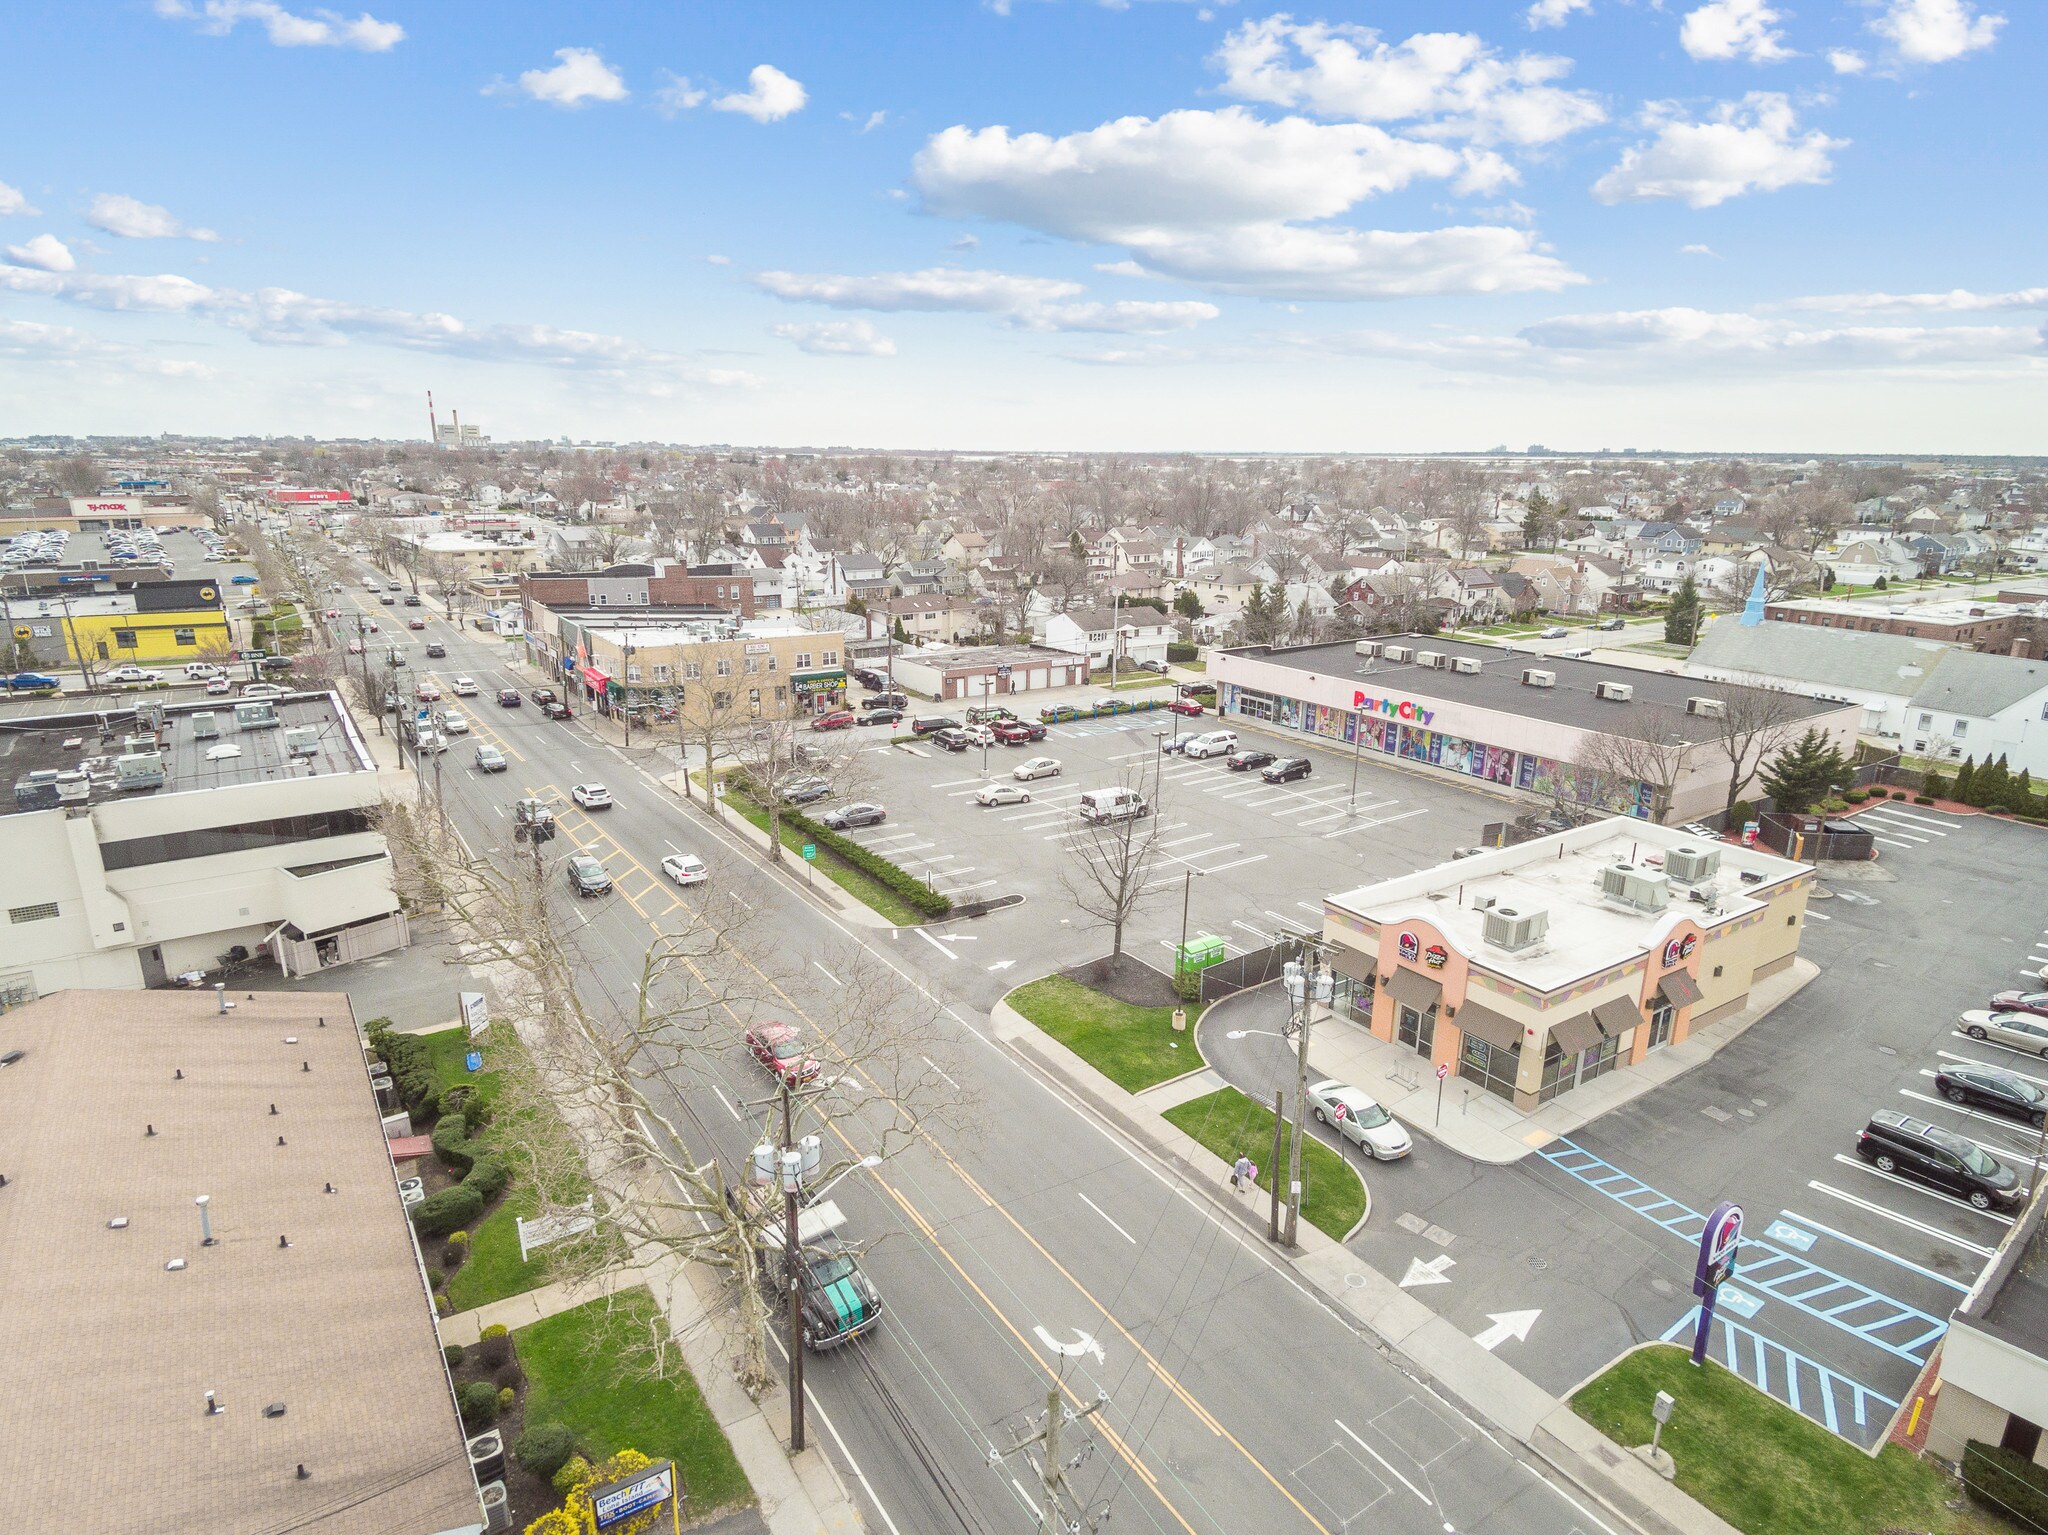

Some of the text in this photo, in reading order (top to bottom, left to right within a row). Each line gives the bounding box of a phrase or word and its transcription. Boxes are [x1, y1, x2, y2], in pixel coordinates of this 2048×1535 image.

[803, 682, 823, 690] BARBER
[824, 680, 838, 689] SHOP
[1425, 951, 1446, 961] Pizza
[600, 1491, 627, 1508] Beach
[628, 1481, 646, 1496] FIT
[602, 1501, 620, 1513] Long
[622, 1491, 644, 1504] Island
[600, 1511, 616, 1521] TRX
